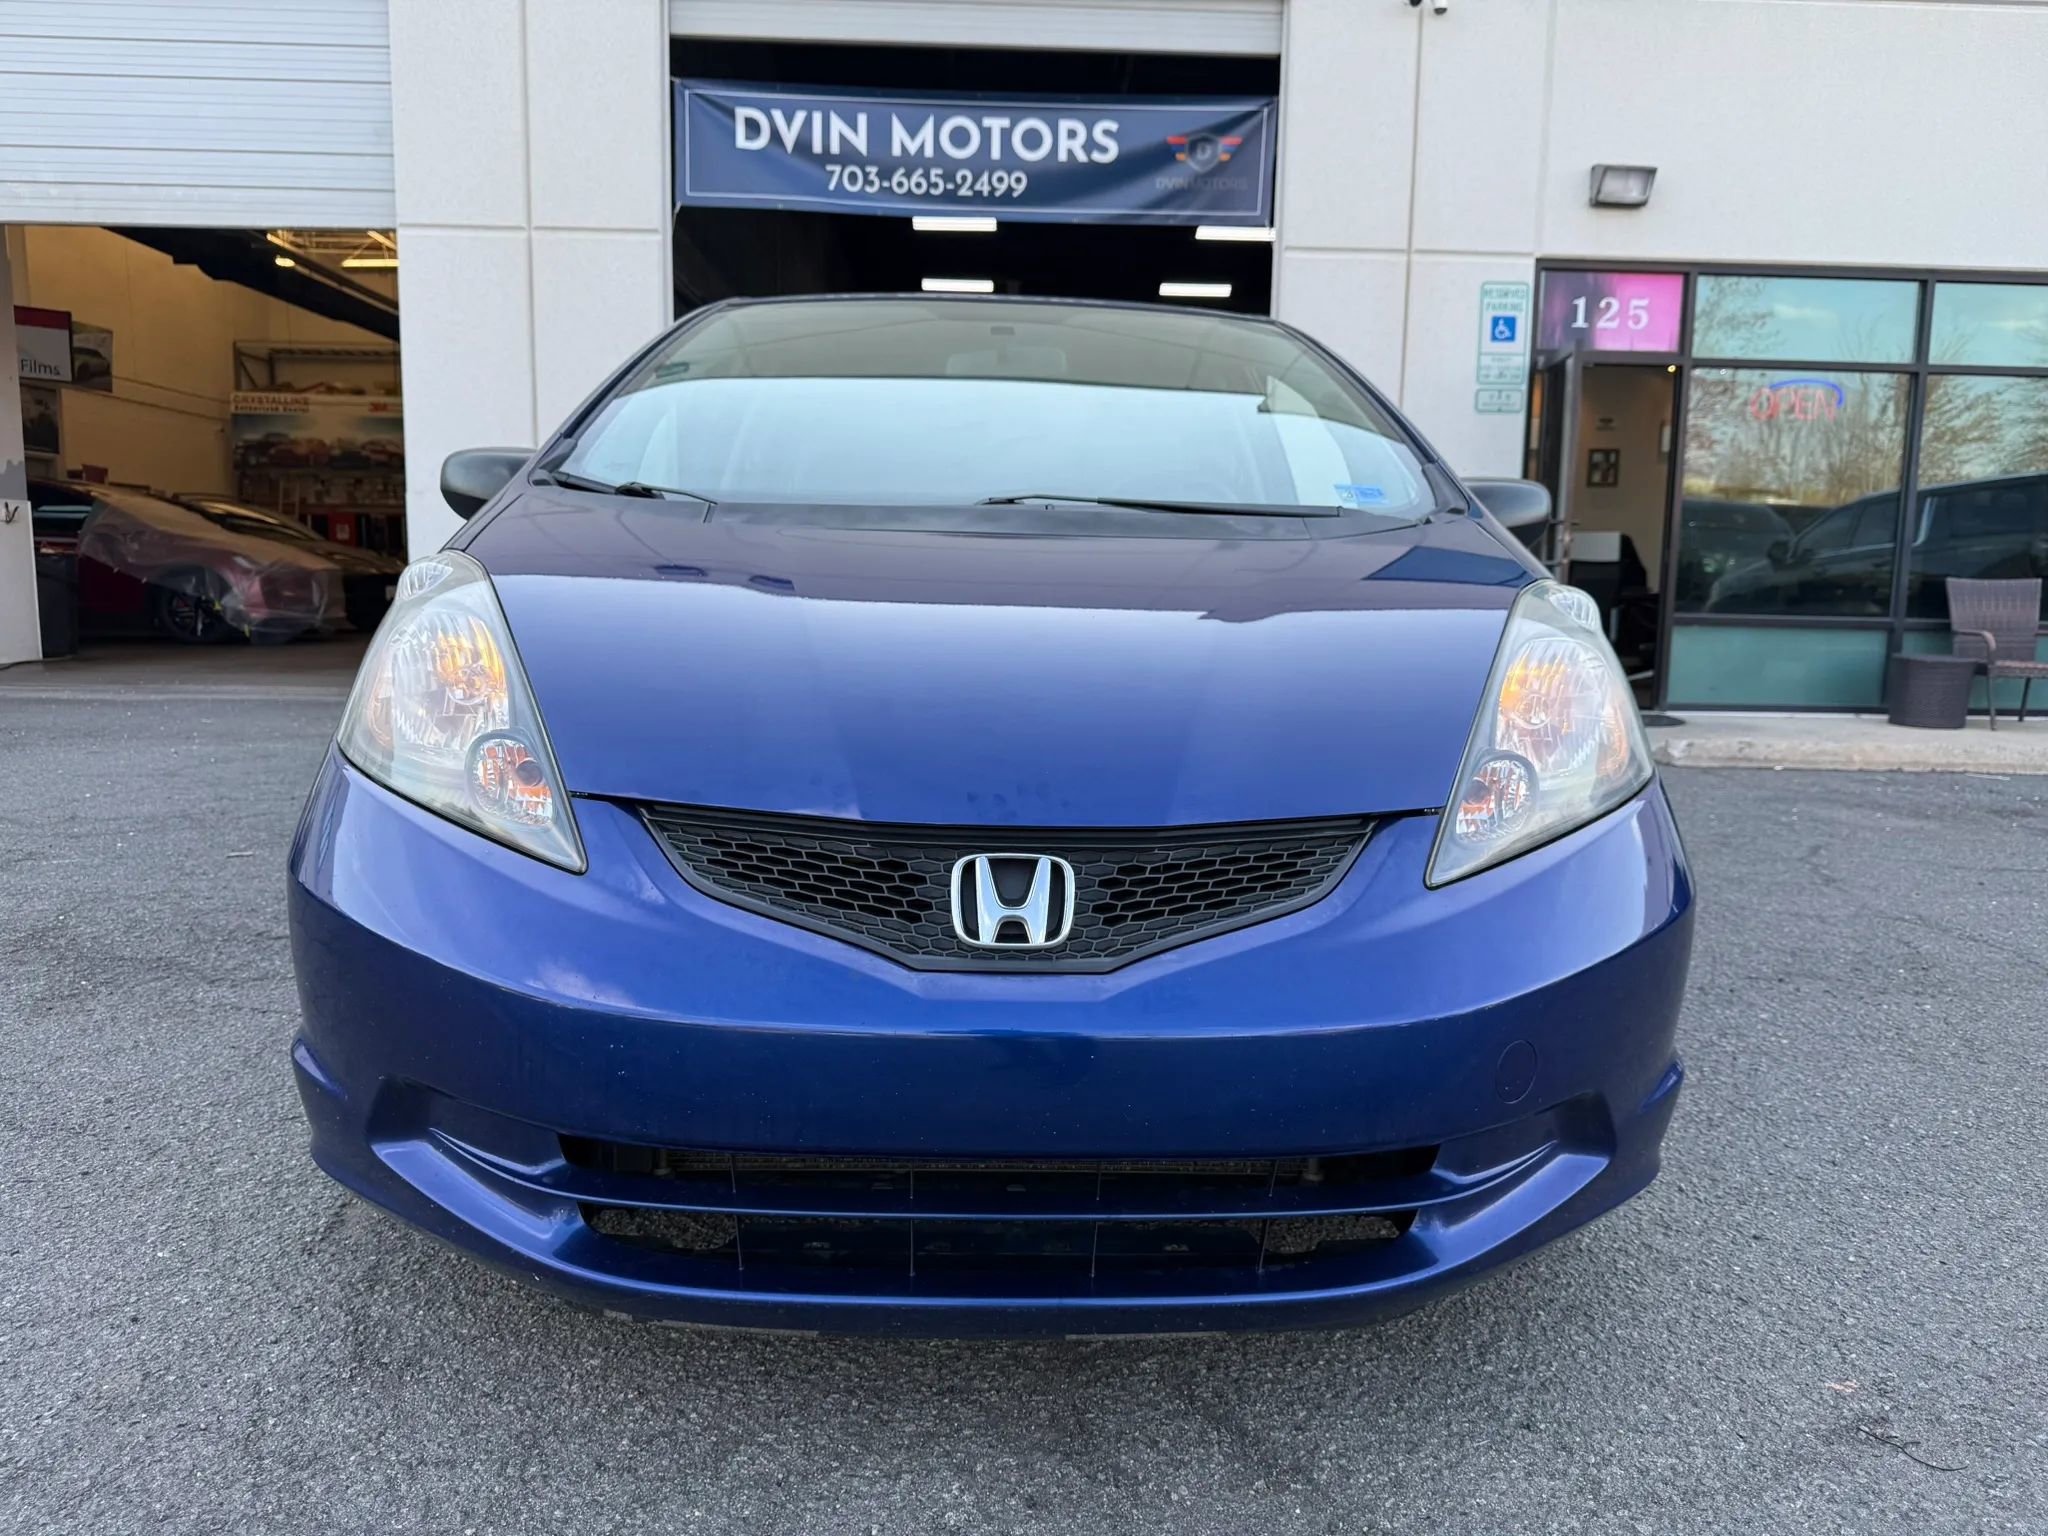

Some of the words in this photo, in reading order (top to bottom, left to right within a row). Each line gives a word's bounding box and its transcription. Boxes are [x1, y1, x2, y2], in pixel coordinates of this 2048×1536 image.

[734, 106, 868, 156] DVIN
[891, 115, 1120, 165] MOTORS
[825, 164, 1028, 199] 703-665-2499
[1571, 296, 1650, 330] 125
[21, 358, 61, 376] Films
[1751, 387, 1836, 422] OPEN
